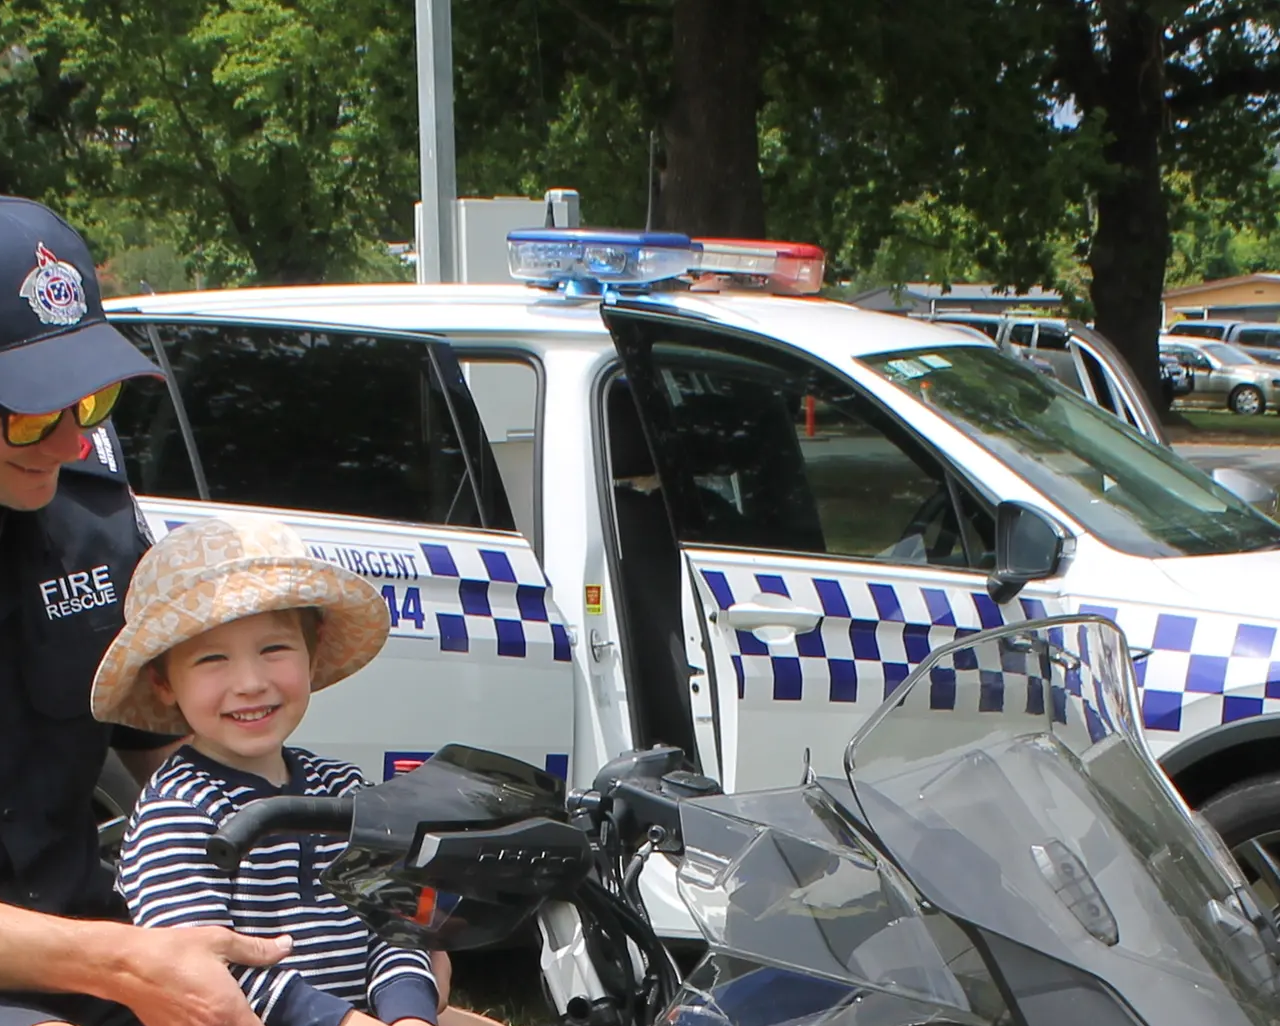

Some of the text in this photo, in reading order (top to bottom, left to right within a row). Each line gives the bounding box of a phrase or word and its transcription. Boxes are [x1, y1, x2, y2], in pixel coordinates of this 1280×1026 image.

[311, 546, 419, 581] N-URGENT
[39, 565, 114, 605] FIRE
[45, 588, 118, 620] RESCUE
